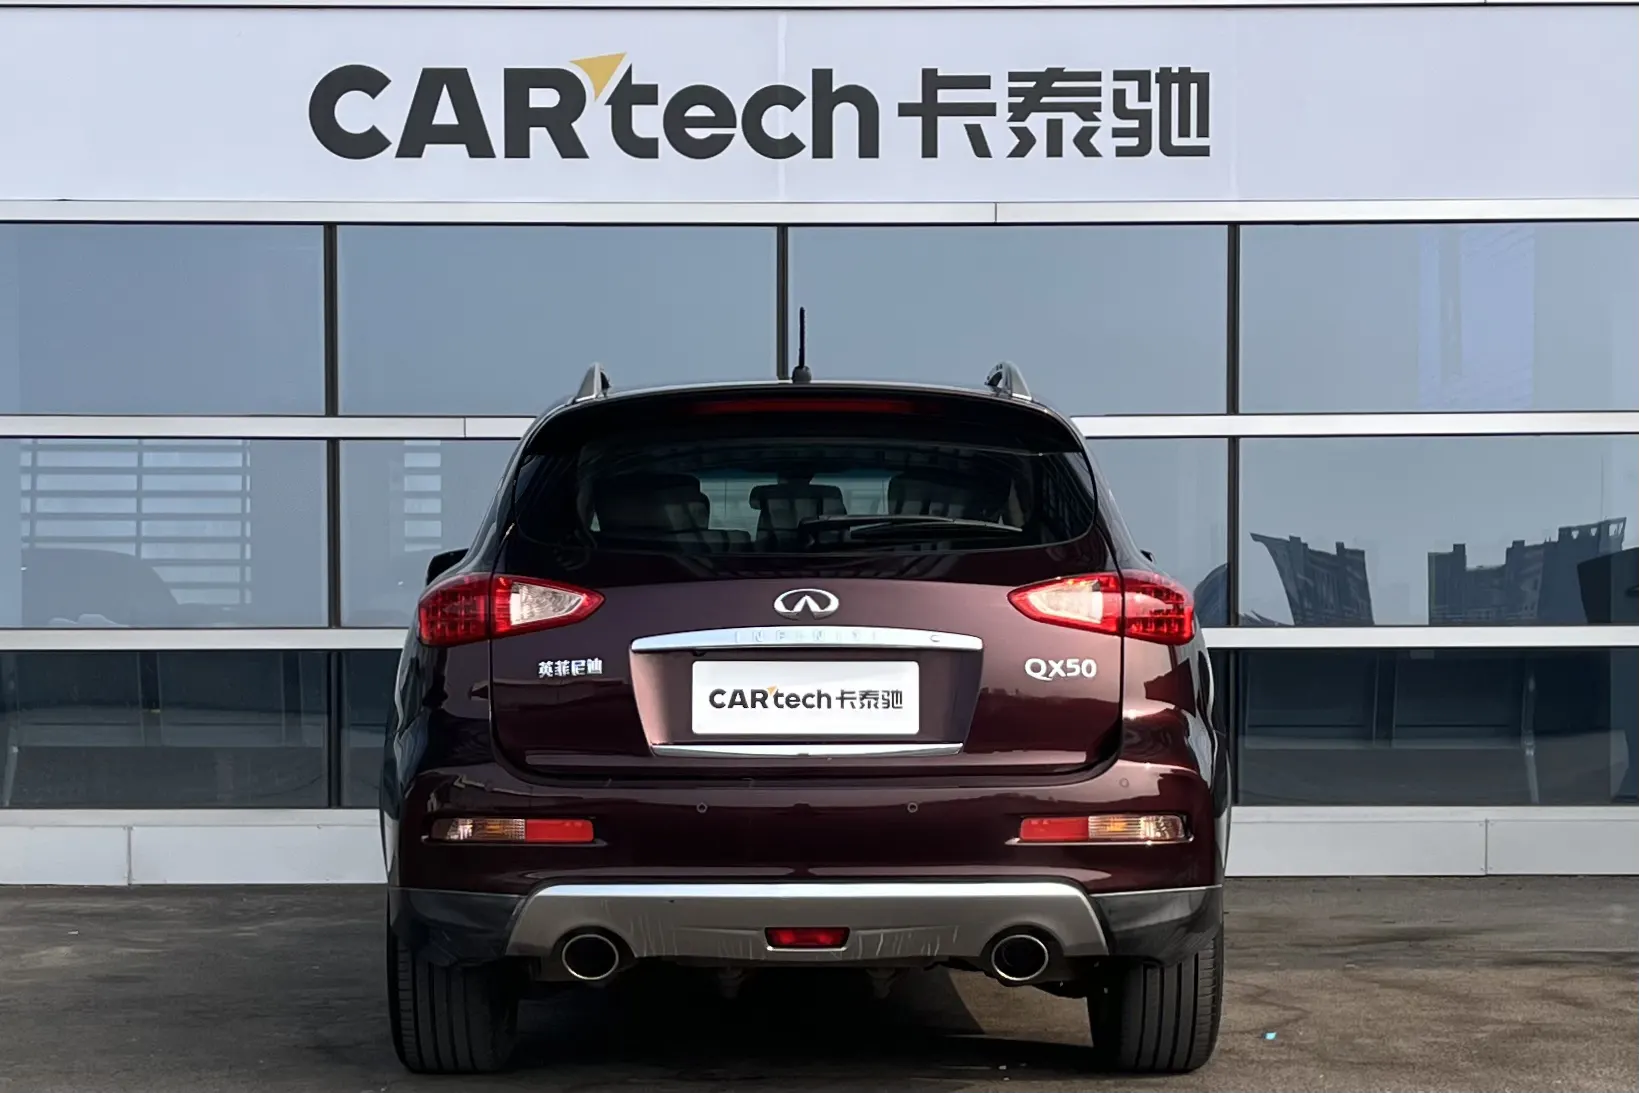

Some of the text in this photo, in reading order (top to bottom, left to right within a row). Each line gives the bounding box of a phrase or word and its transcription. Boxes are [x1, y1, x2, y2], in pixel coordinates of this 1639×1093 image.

[309, 64, 1211, 159] CARtech 卡泰驰
[538, 657, 603, 678] 英菲尼迪
[1024, 658, 1097, 681] QX50
[709, 688, 903, 709] CARtech 卡泰驰
